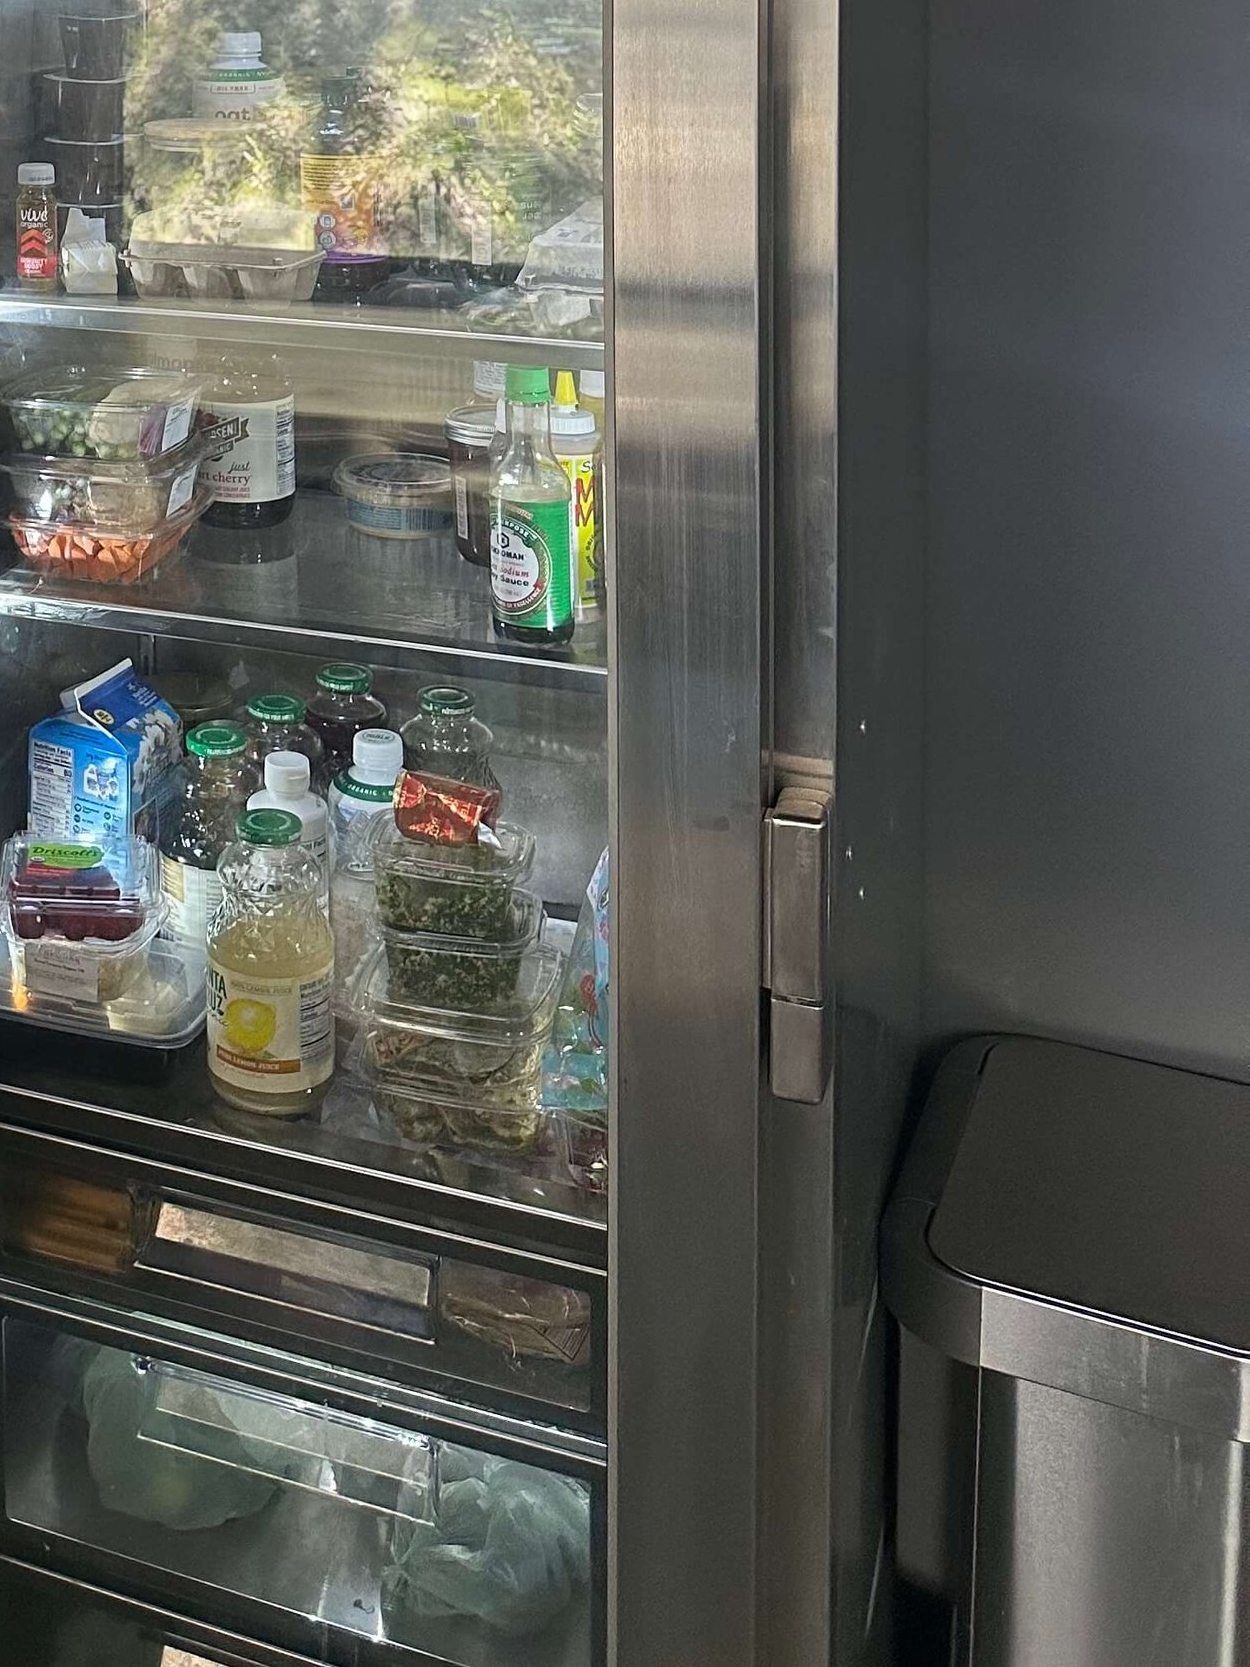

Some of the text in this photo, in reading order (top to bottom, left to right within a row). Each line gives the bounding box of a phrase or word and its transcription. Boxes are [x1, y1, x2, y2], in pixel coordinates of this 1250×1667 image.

[20, 221, 48, 229] organic
[227, 462, 250, 474] just
[212, 471, 252, 485] cherry
[500, 574, 530, 587] Sauce
[347, 784, 378, 797] ORGANIC
